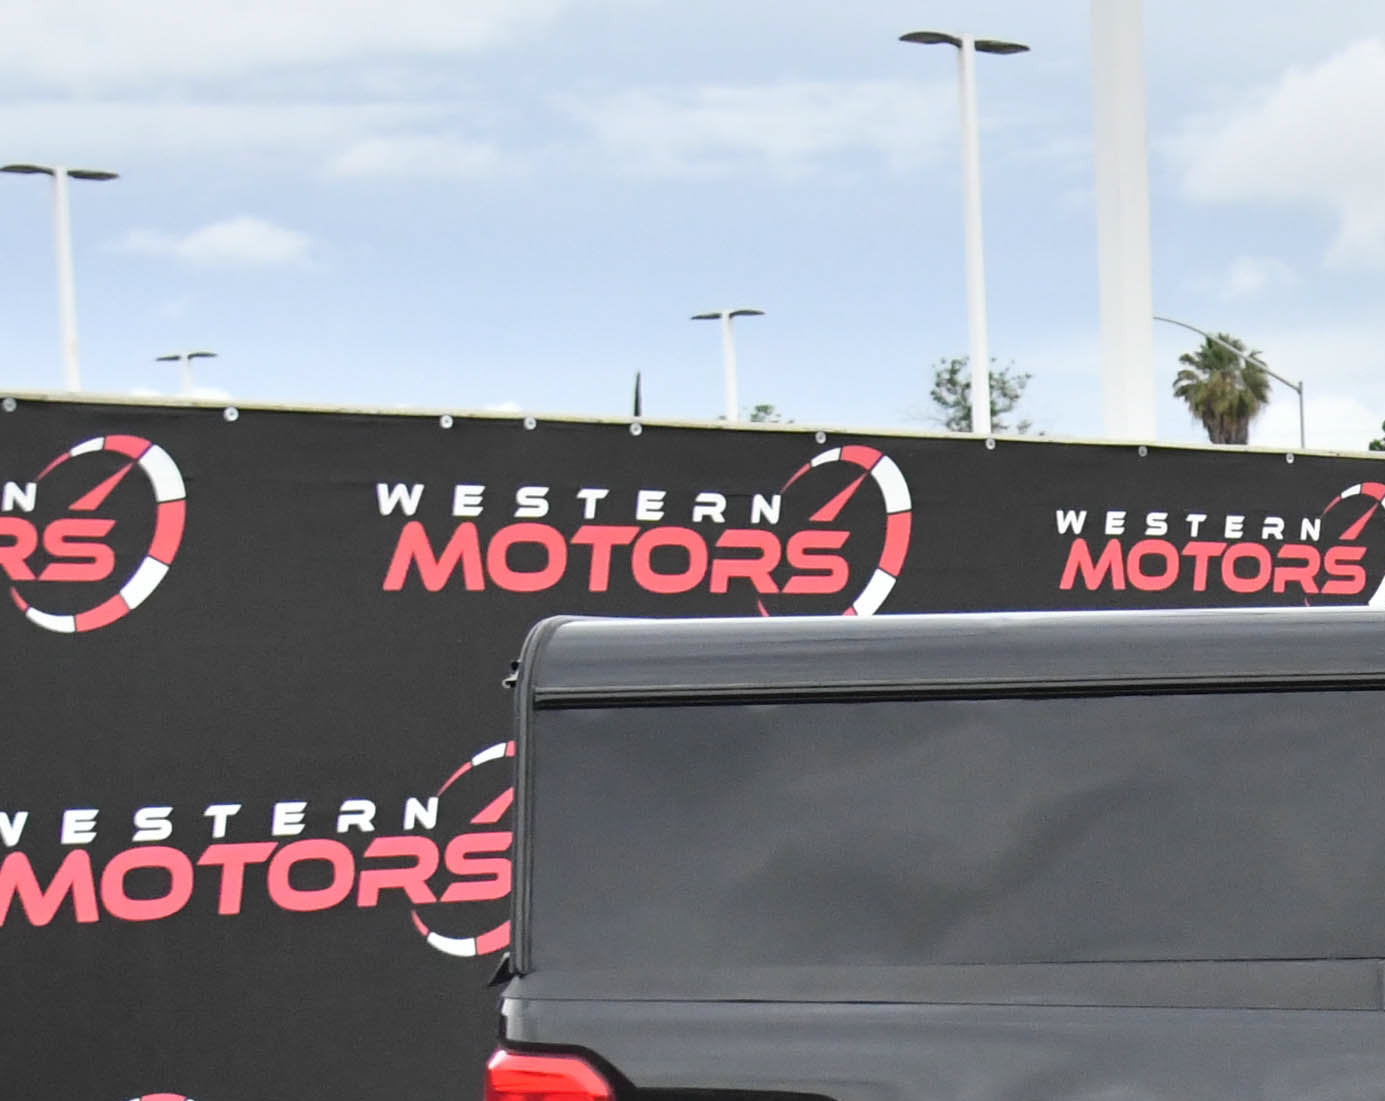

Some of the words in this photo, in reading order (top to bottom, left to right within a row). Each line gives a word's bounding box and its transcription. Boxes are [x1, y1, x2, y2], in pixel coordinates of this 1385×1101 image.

[377, 483, 782, 525] WESTERN
[1056, 510, 1321, 542] WESTERN
[382, 520, 851, 595] MOTORS
[1059, 537, 1367, 595] MOTORS
[0, 796, 439, 847] WESTERN
[0, 831, 513, 927] MOTORS
